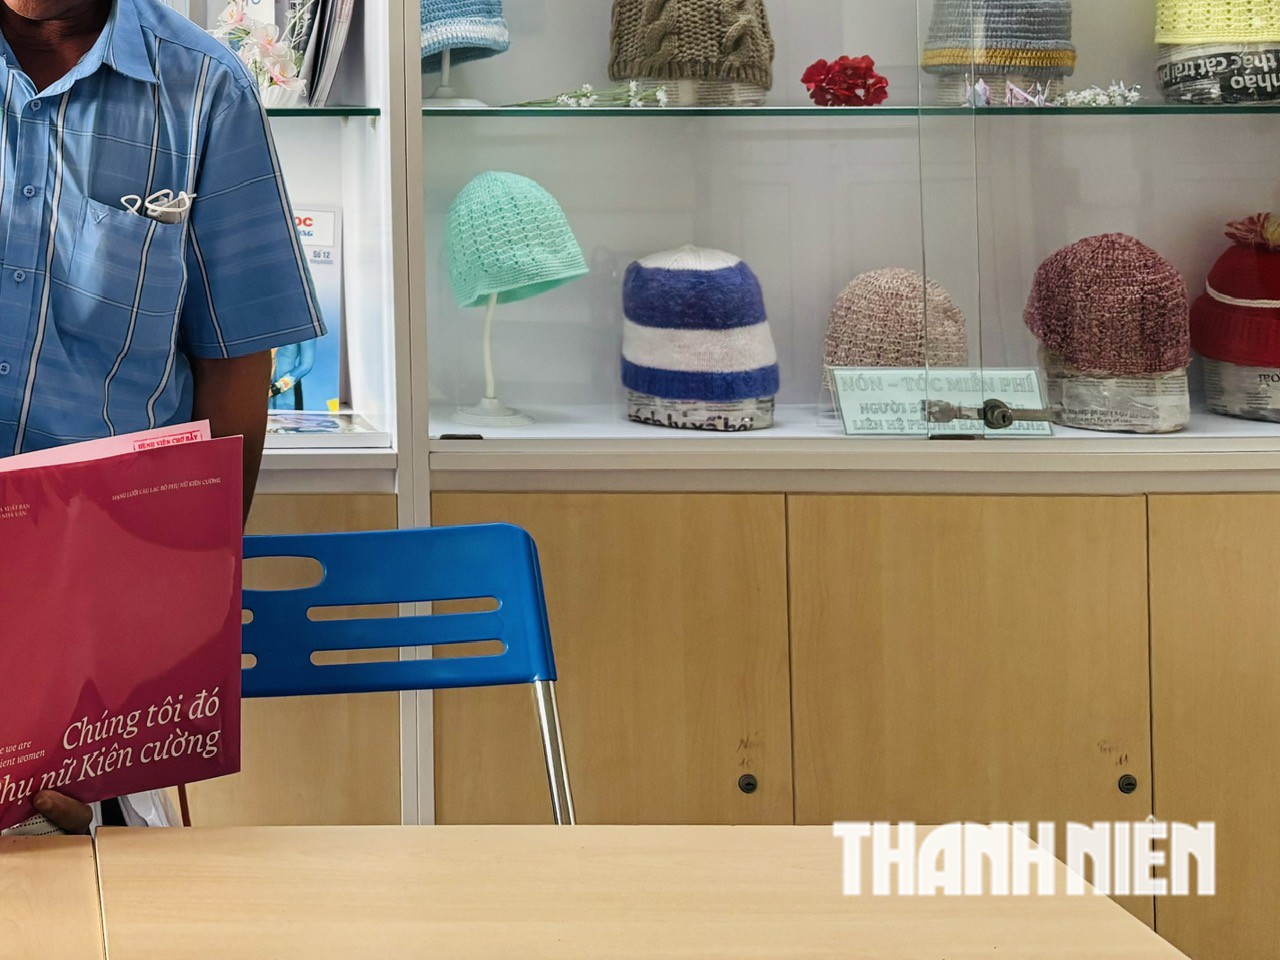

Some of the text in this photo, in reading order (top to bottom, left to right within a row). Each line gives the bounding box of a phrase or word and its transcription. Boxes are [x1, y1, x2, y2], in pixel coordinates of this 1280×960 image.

[62, 686, 220, 751] Chúng tôi đó
[5, 743, 17, 753] we
[17, 740, 32, 750] are
[16, 749, 46, 764] women
[40, 758, 76, 792] nữ
[76, 742, 133, 782] Kiên
[140, 727, 222, 759] cường
